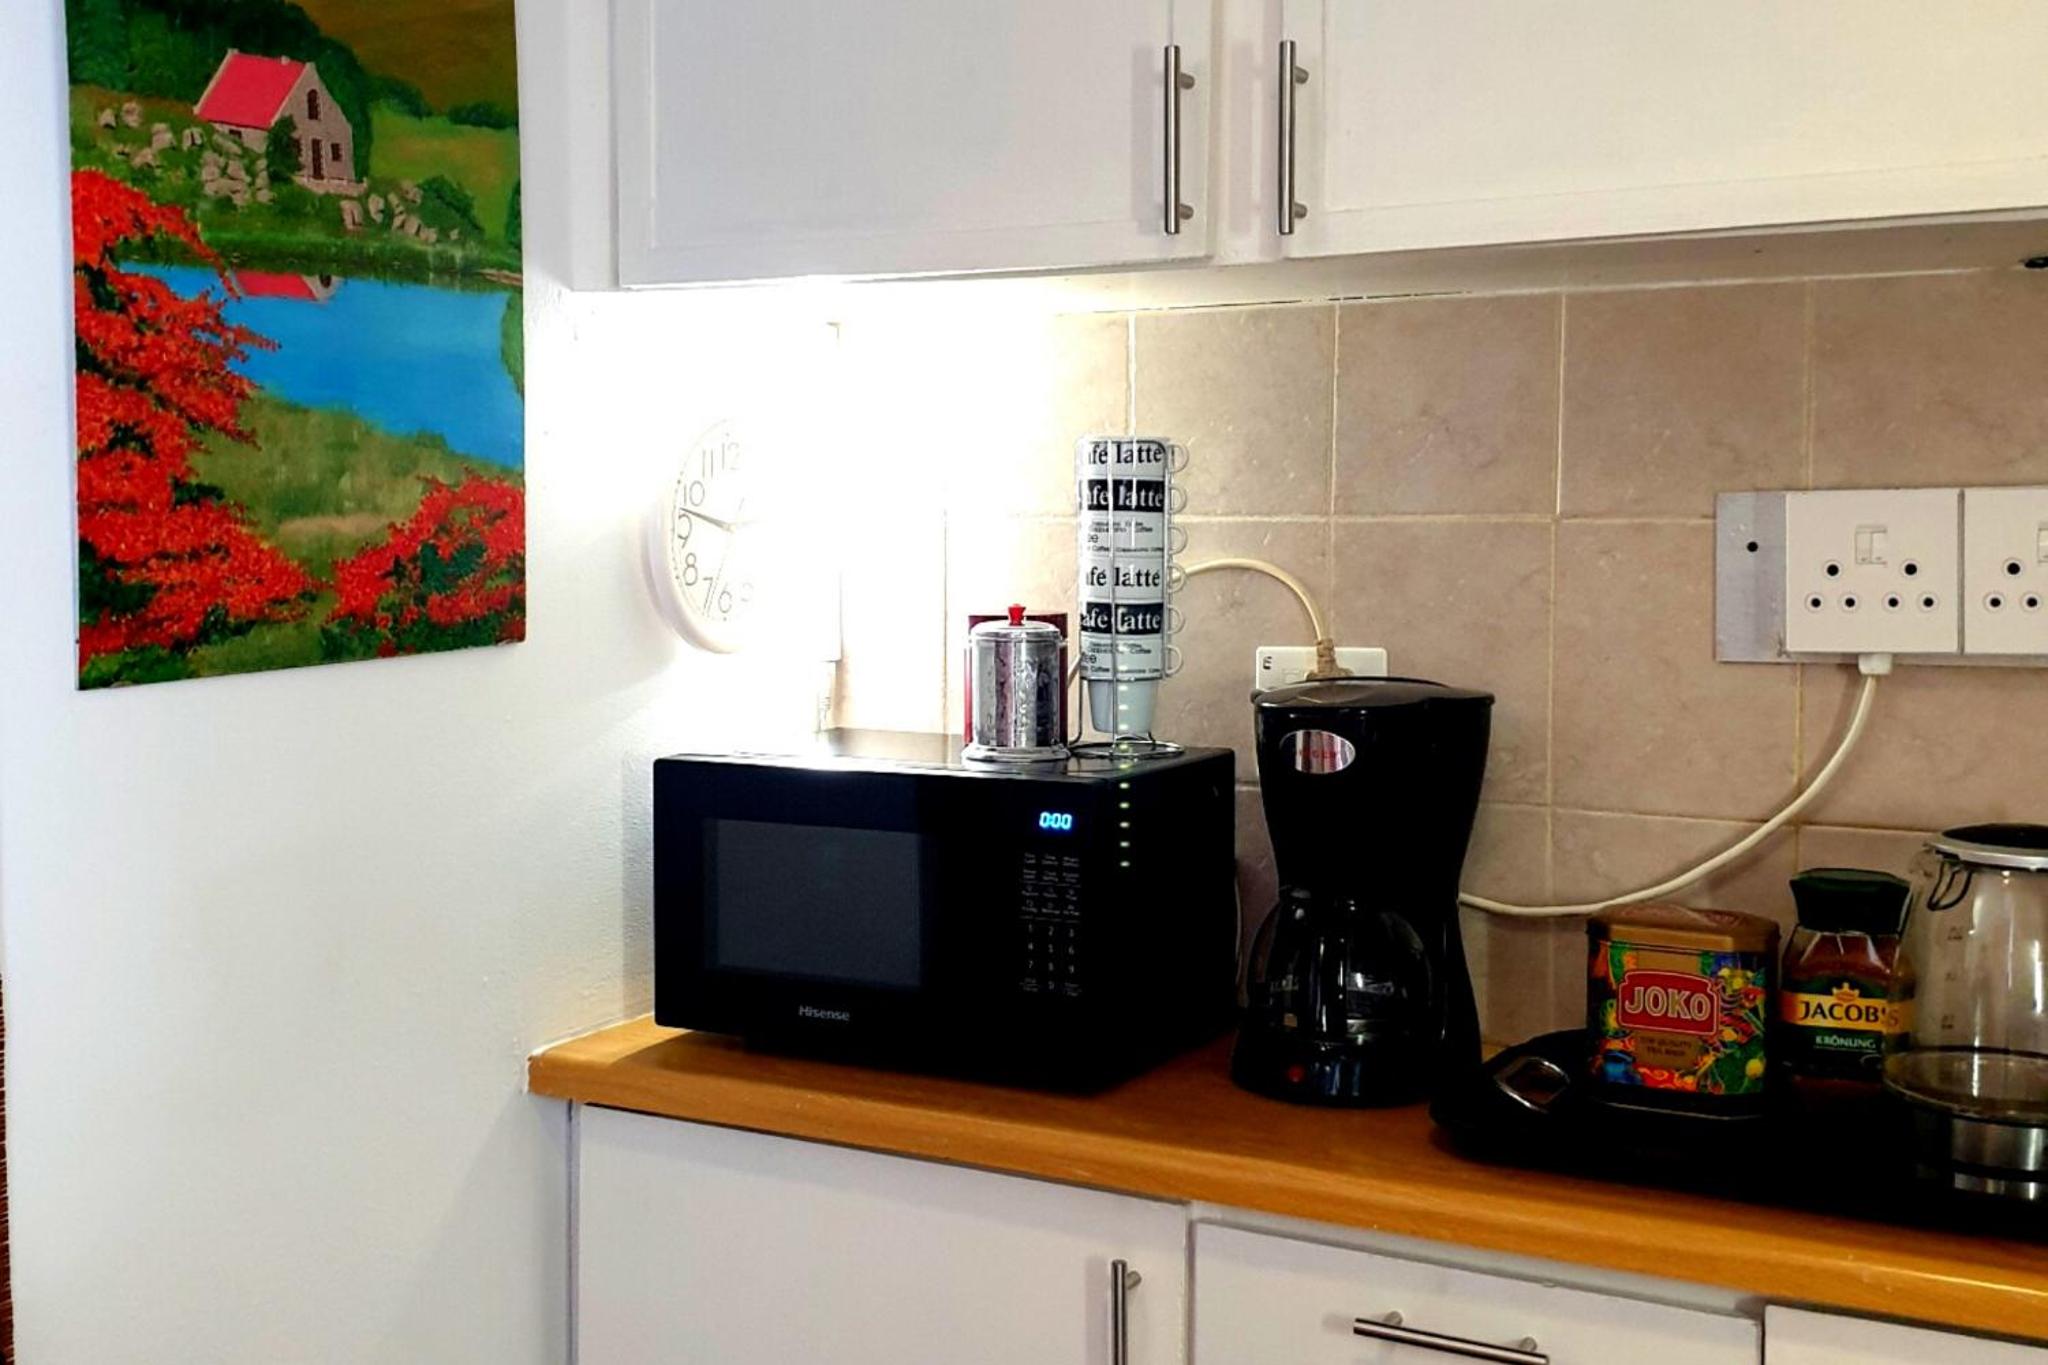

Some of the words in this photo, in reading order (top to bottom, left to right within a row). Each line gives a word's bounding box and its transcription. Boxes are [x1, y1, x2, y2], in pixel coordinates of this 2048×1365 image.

[702, 449, 714, 478] 11
[682, 480, 705, 507] 10
[682, 552, 698, 587] 8
[702, 576, 714, 611] 7
[797, 1004, 851, 1022] Hisense
[1624, 986, 1711, 1021] JOKO
